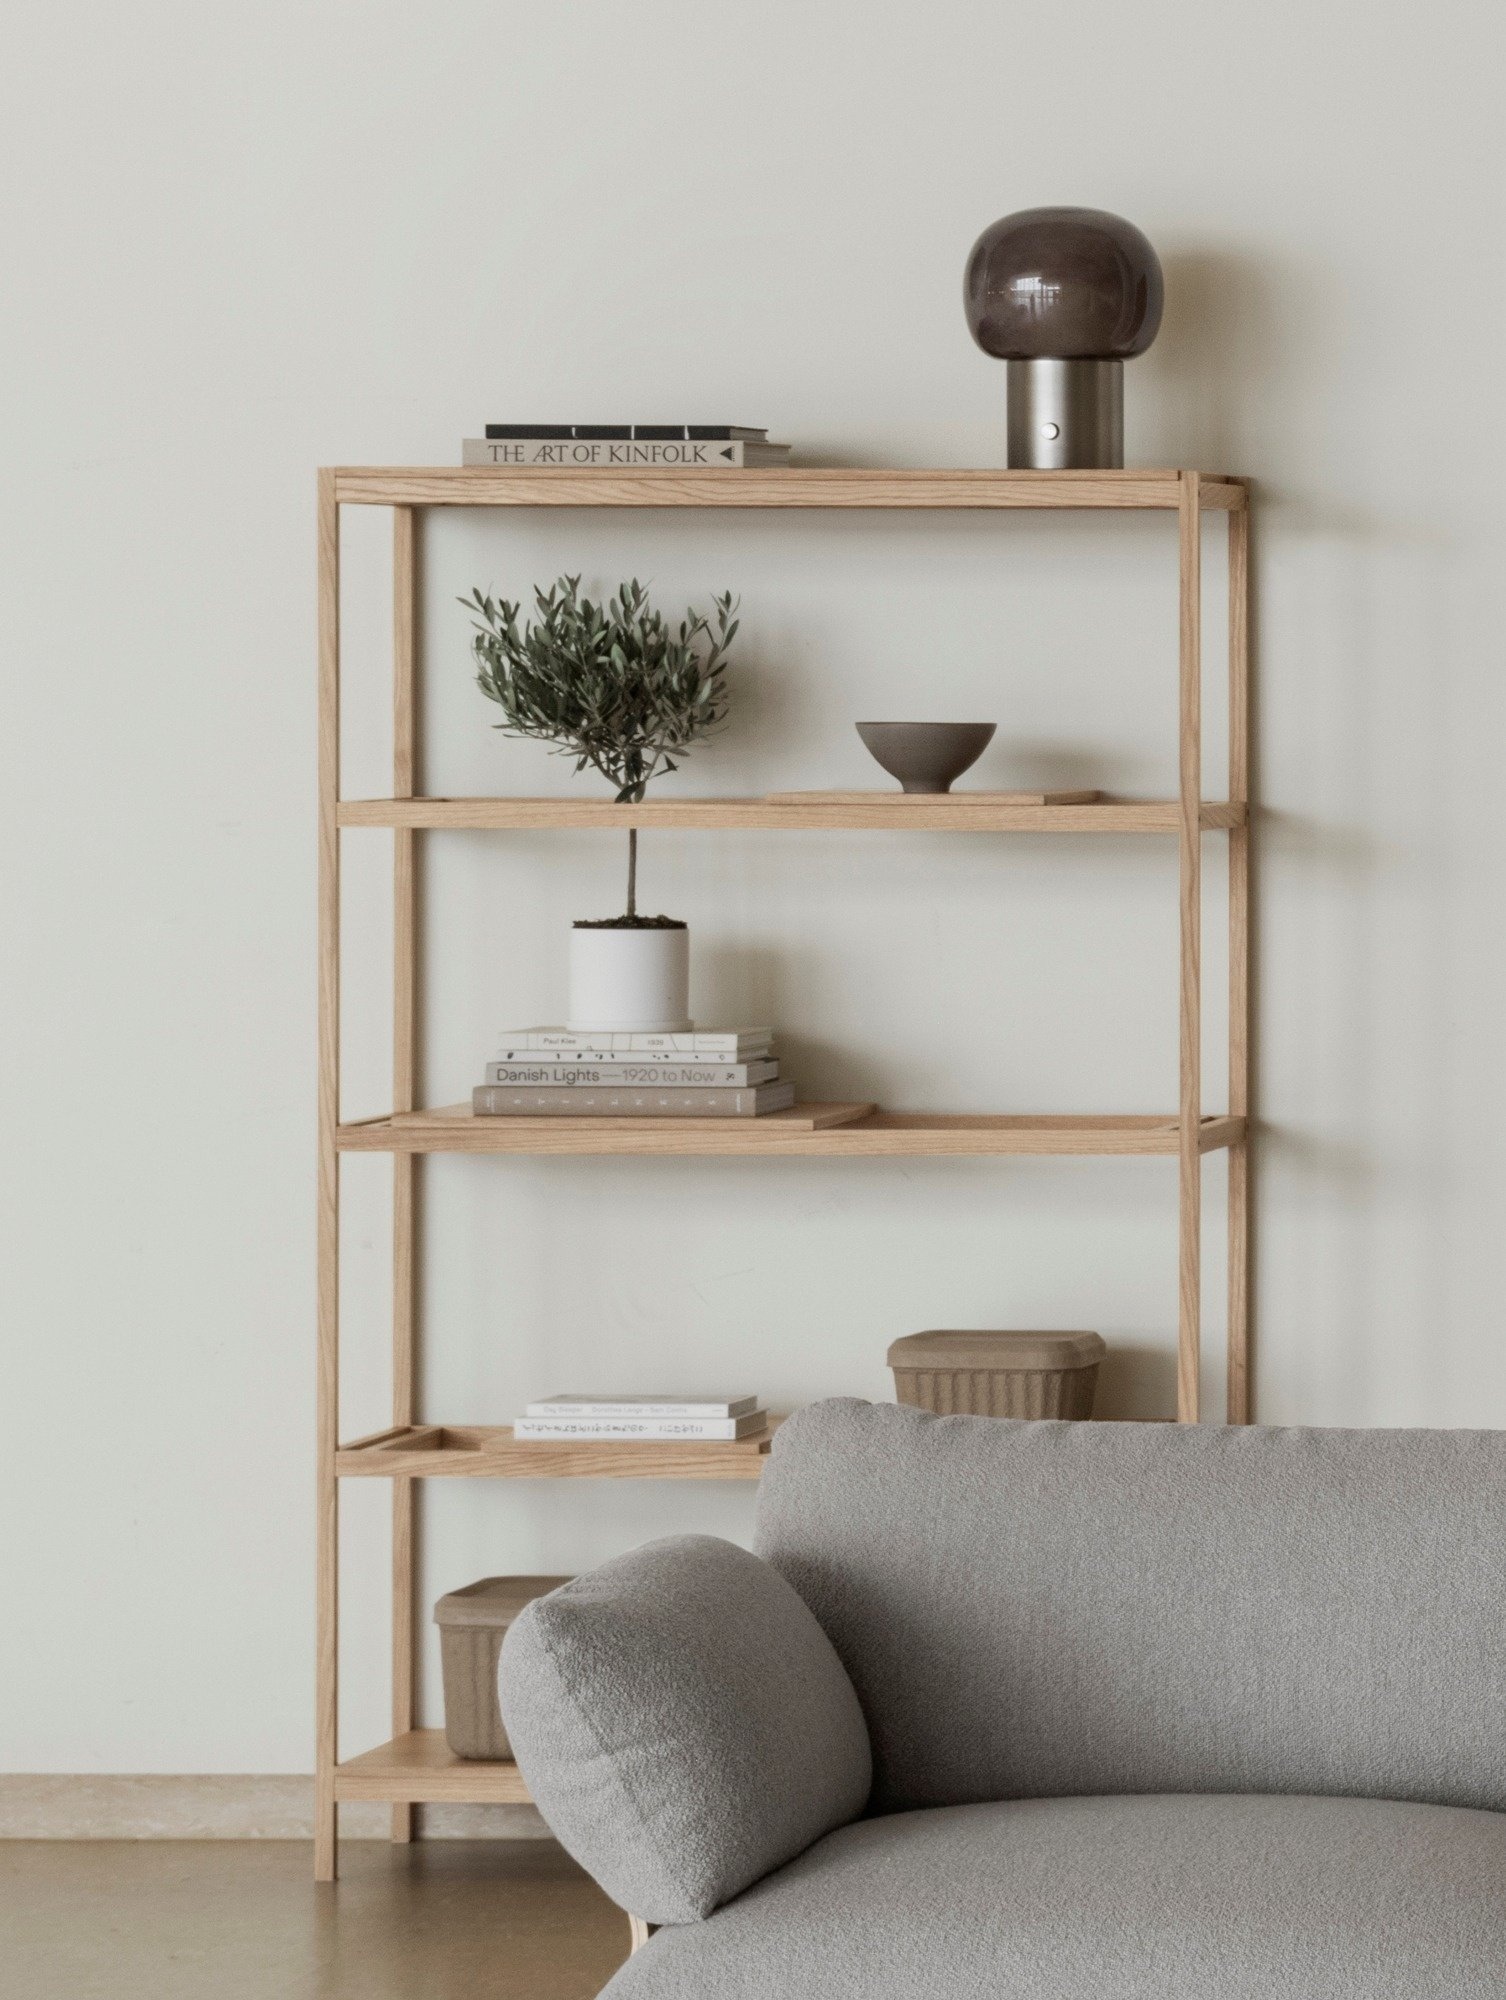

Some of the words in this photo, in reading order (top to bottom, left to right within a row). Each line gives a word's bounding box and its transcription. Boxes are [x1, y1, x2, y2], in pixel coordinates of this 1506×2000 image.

[488, 445, 525, 463] THE
[532, 445, 569, 463] ART
[572, 445, 601, 463] OF
[608, 445, 708, 463] KINFOLK
[543, 1037, 560, 1045] Paul
[496, 1068, 549, 1082] Danish
[662, 1069, 678, 1082] to
[680, 1069, 716, 1082] Now
